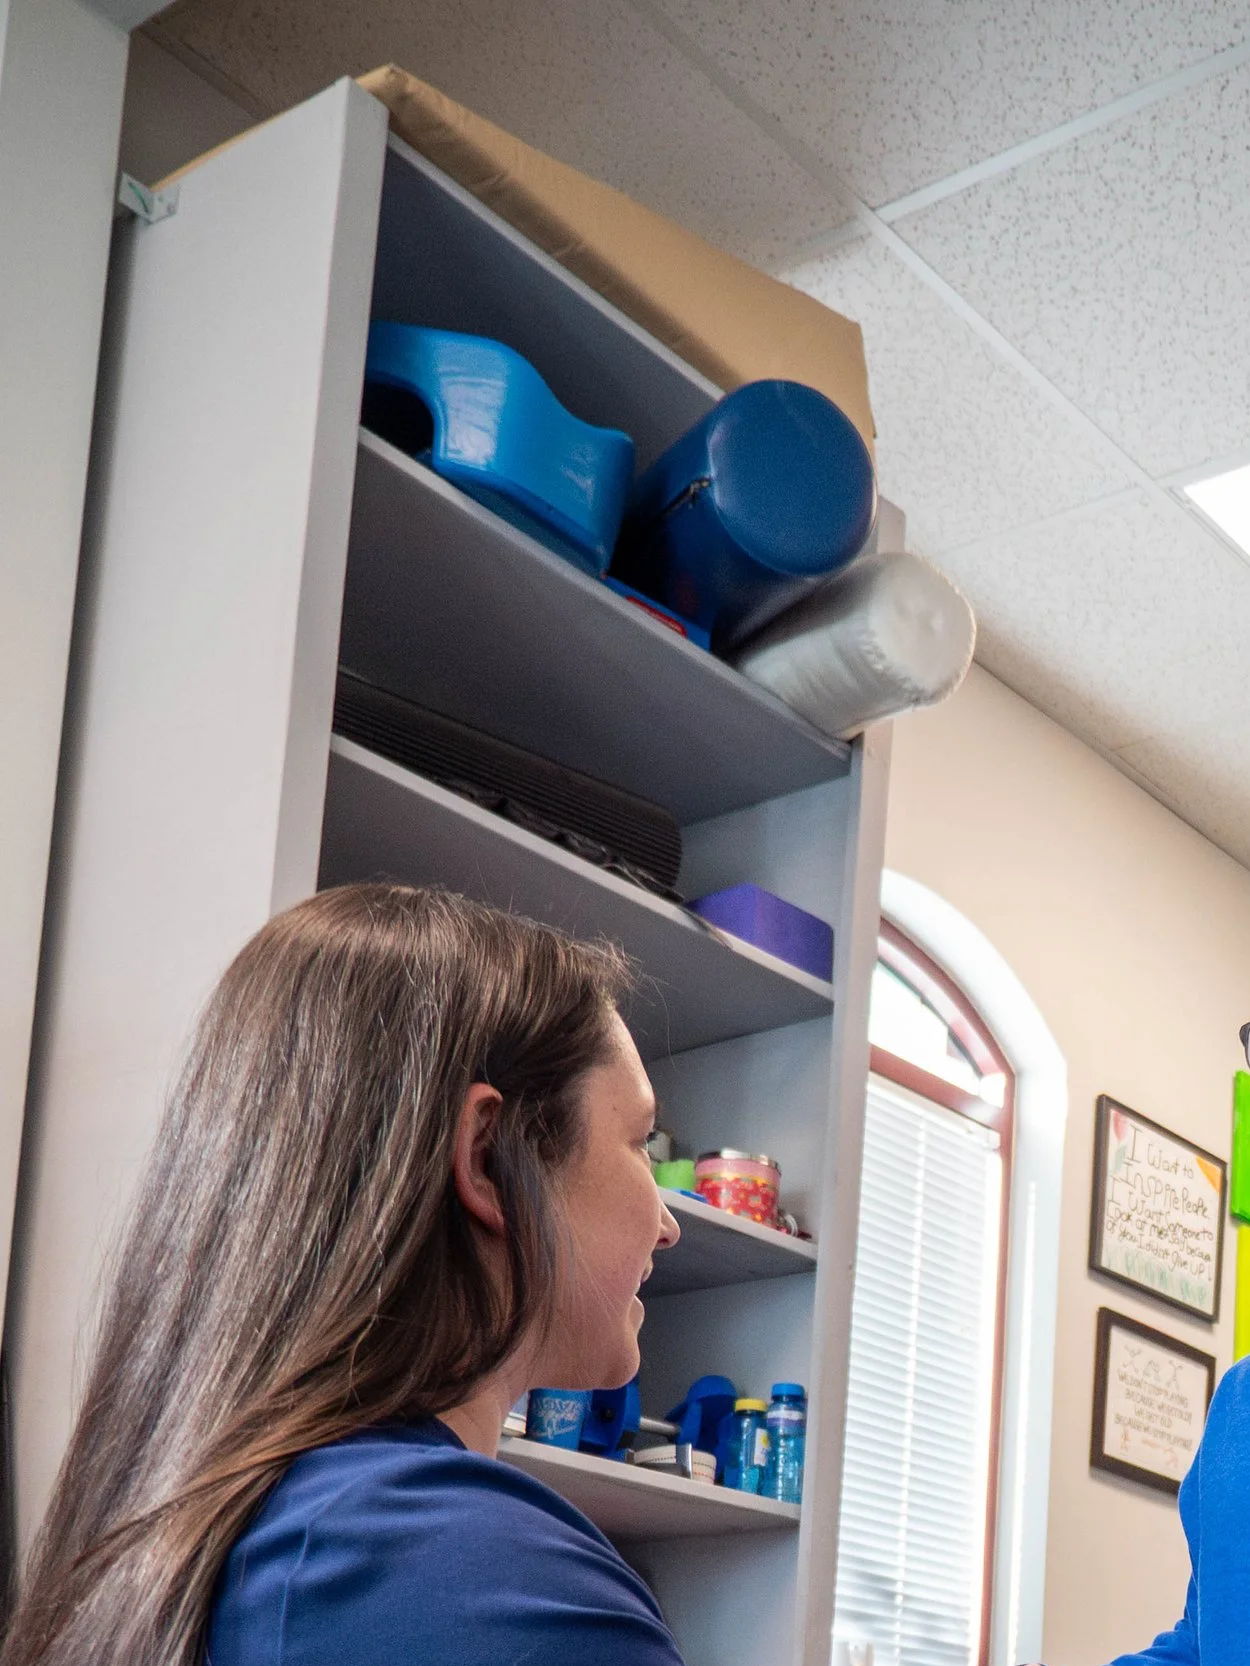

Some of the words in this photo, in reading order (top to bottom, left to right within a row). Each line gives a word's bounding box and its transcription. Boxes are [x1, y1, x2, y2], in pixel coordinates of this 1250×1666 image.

[1126, 1123, 1144, 1164] I
[1183, 1163, 1195, 1180] to
[1109, 1176, 1121, 1206] I
[1200, 1226, 1214, 1241] to
